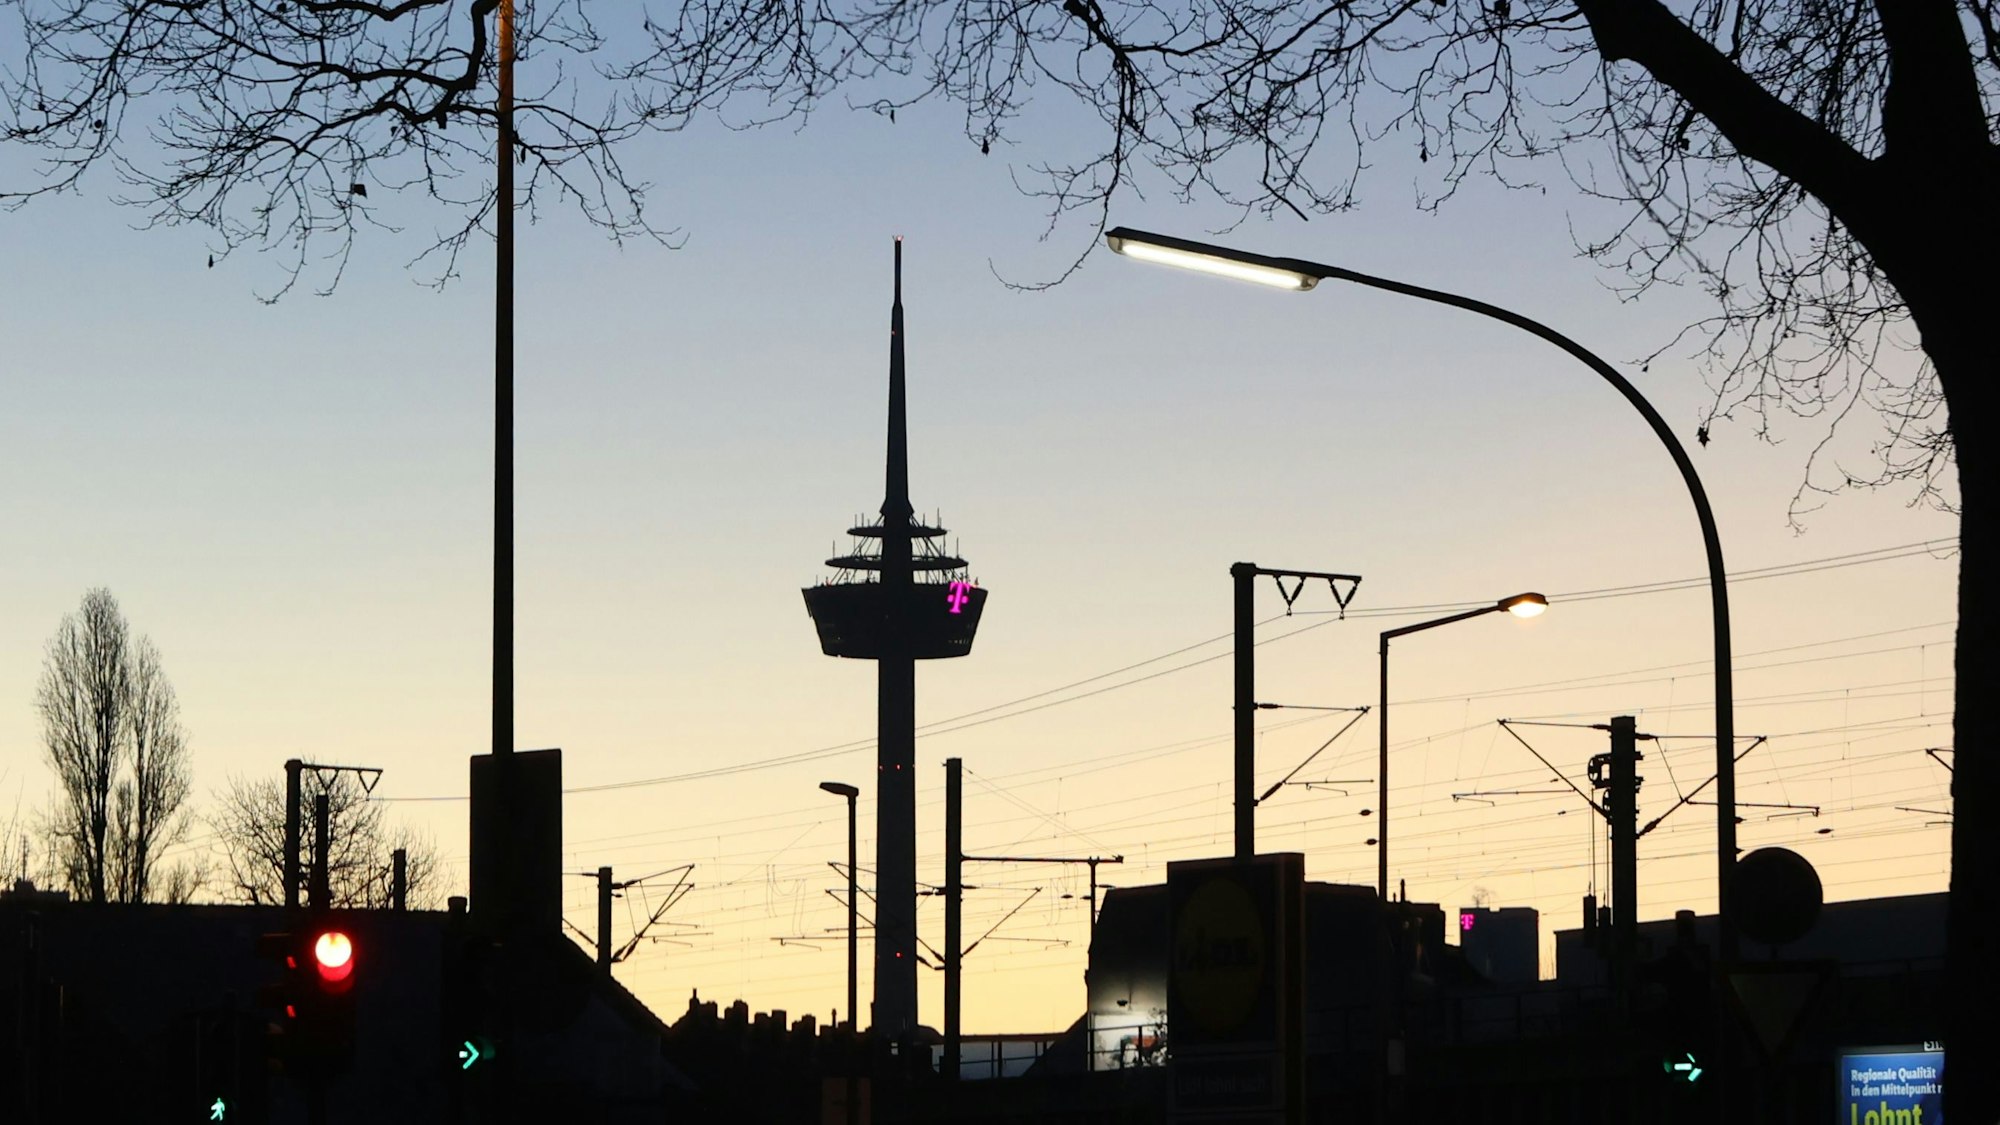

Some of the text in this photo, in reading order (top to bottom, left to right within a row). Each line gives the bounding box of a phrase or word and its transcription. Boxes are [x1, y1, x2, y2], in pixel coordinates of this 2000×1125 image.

[947, 580, 971, 614] T
[1461, 914, 1474, 930] T
[1850, 1066, 1936, 1083] Regionale Qualität
[1862, 1084, 1880, 1096] den
[1881, 1083, 1937, 1098] Mittelpunkt
